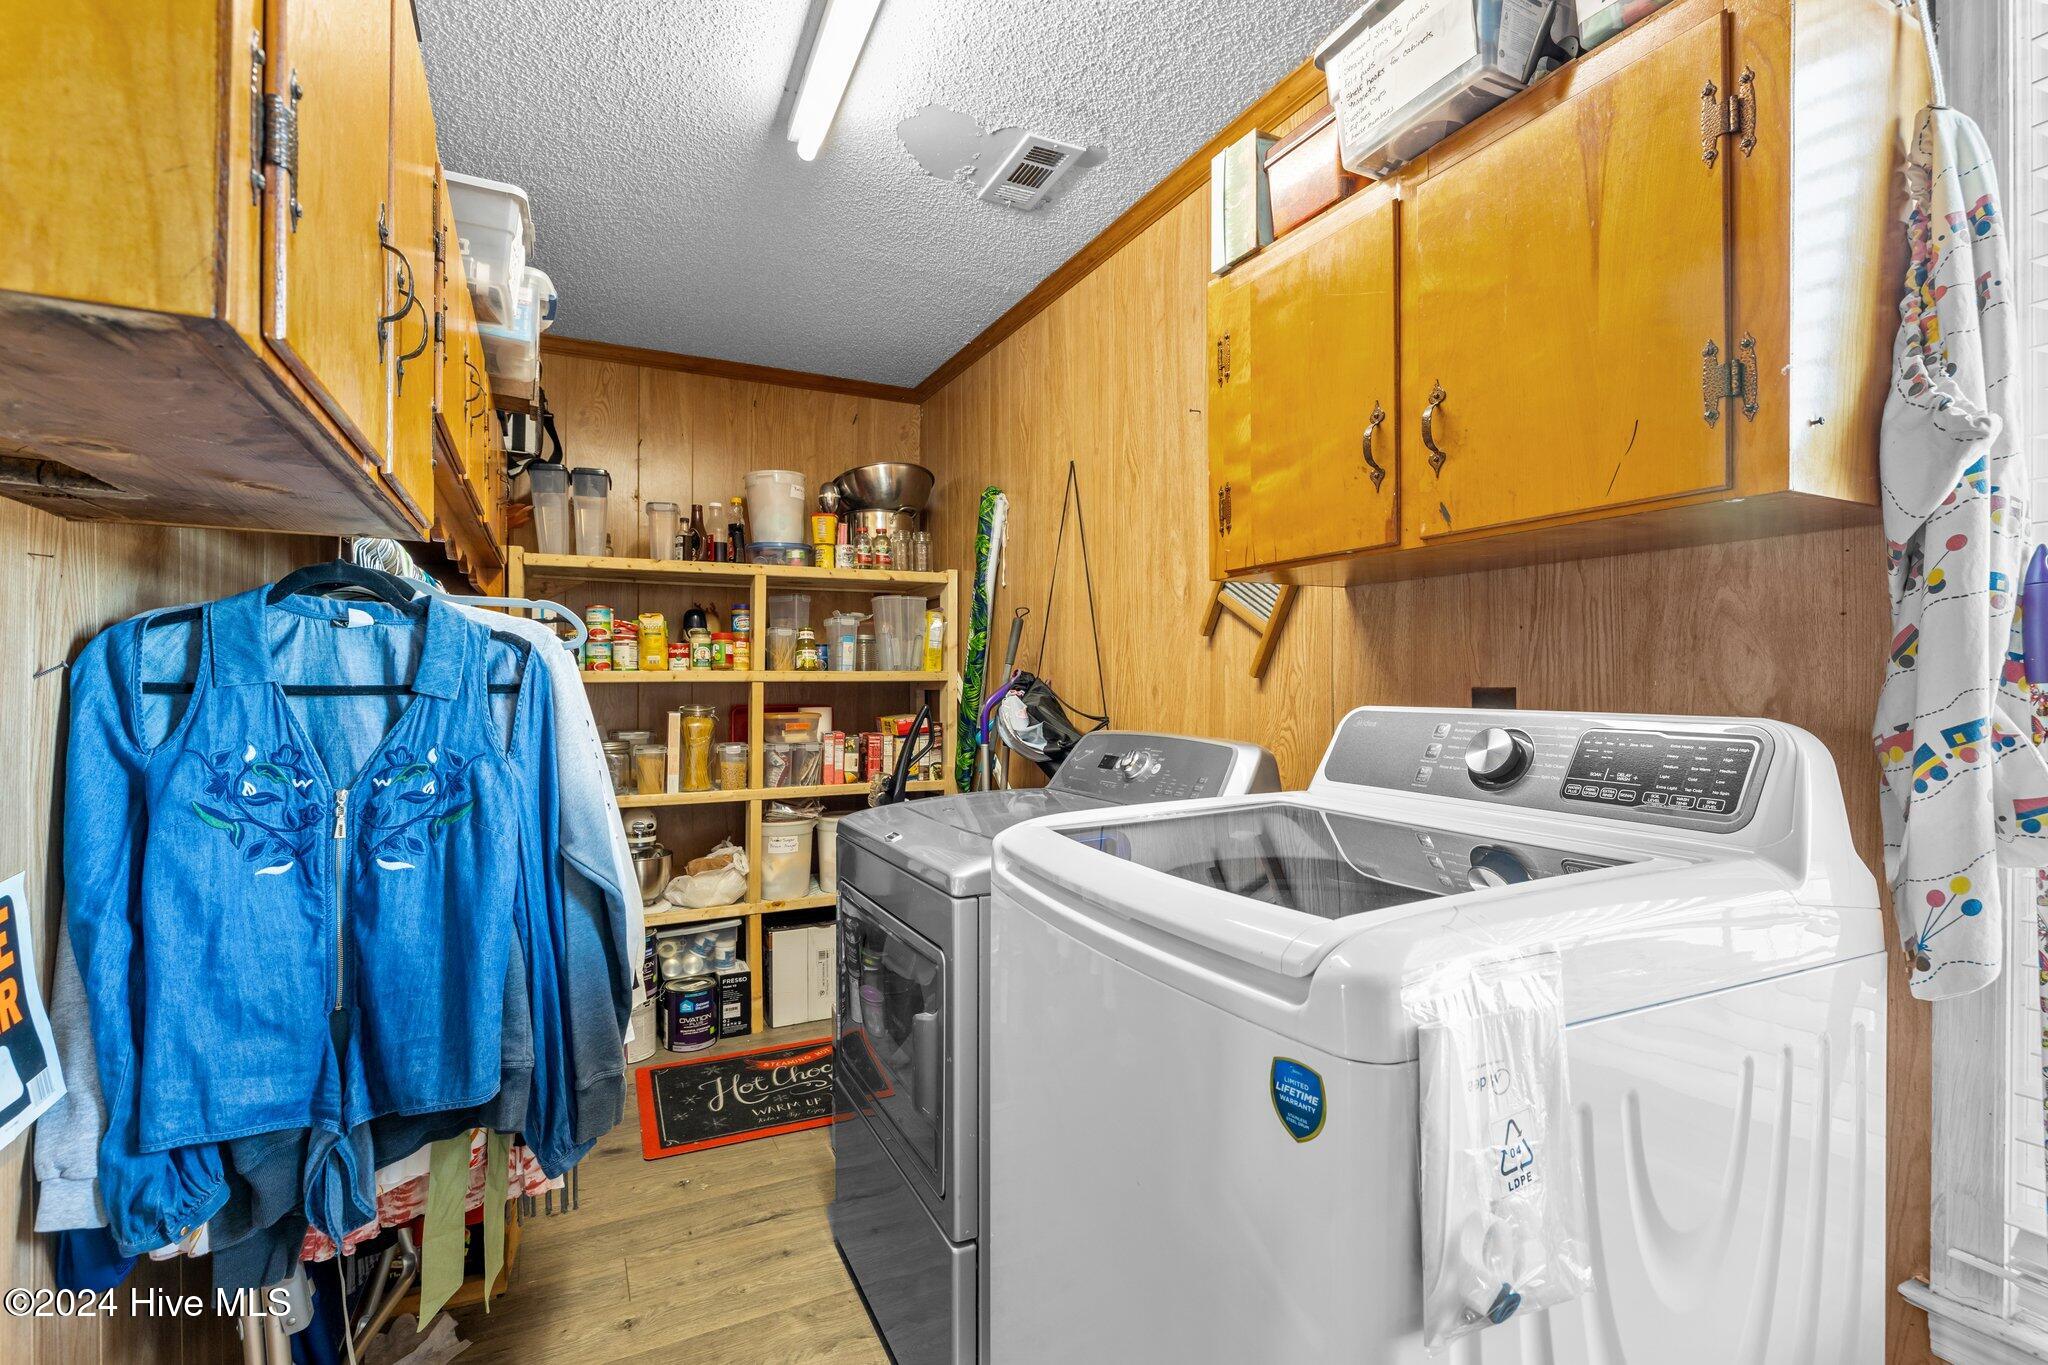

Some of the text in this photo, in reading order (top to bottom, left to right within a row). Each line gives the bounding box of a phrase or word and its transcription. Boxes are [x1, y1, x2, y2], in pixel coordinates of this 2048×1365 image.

[1390, 56, 1400, 66] for
[679, 1013, 712, 1024] OVATION
[763, 1055, 811, 1067] STEAMING
[1284, 1076, 1309, 1091] LIMITED
[698, 1073, 769, 1112] Hot
[1275, 1081, 1319, 1106] LIFETIME
[752, 1097, 821, 1116] WARM UP
[1279, 1093, 1316, 1114] WARRANTY
[1510, 1145, 1521, 1158] 04
[1508, 1172, 1532, 1191] LDPE
